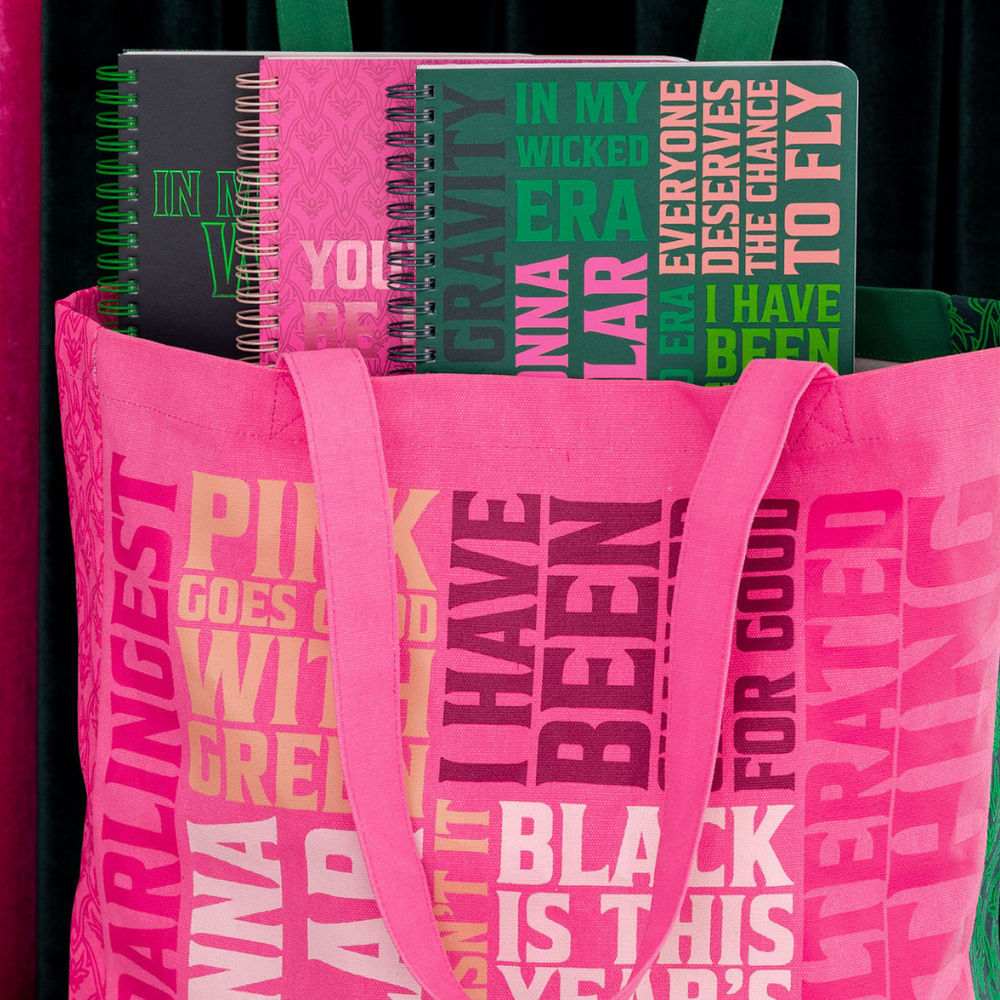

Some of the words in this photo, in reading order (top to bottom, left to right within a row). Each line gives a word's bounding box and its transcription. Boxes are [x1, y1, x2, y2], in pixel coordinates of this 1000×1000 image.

[515, 81, 559, 124] IN
[575, 81, 649, 124] MY
[786, 80, 842, 182] FLY
[515, 135, 649, 168] WICKED
[659, 80, 697, 275] EVERYONE
[702, 79, 741, 275] DESERVES
[746, 79, 778, 203] CHANCE
[153, 170, 200, 217] IN
[443, 84, 505, 363] GRAVITY
[515, 179, 649, 242] ERA
[745, 213, 777, 276] THE
[784, 202, 840, 276] TO
[515, 254, 569, 379] NNA
[659, 284, 695, 355] ERA
[705, 284, 717, 323] I
[733, 284, 841, 323] HAVE
[705, 328, 840, 378] BEEN
[177, 574, 297, 630] GOES
[442, 490, 541, 728] HAVE
[736, 499, 799, 653] GOOD
[535, 496, 662, 791] BEEN
[734, 672, 797, 792] FOR
[434, 798, 490, 854] IT
[496, 891, 571, 963] IS
[601, 893, 794, 966] THIS
